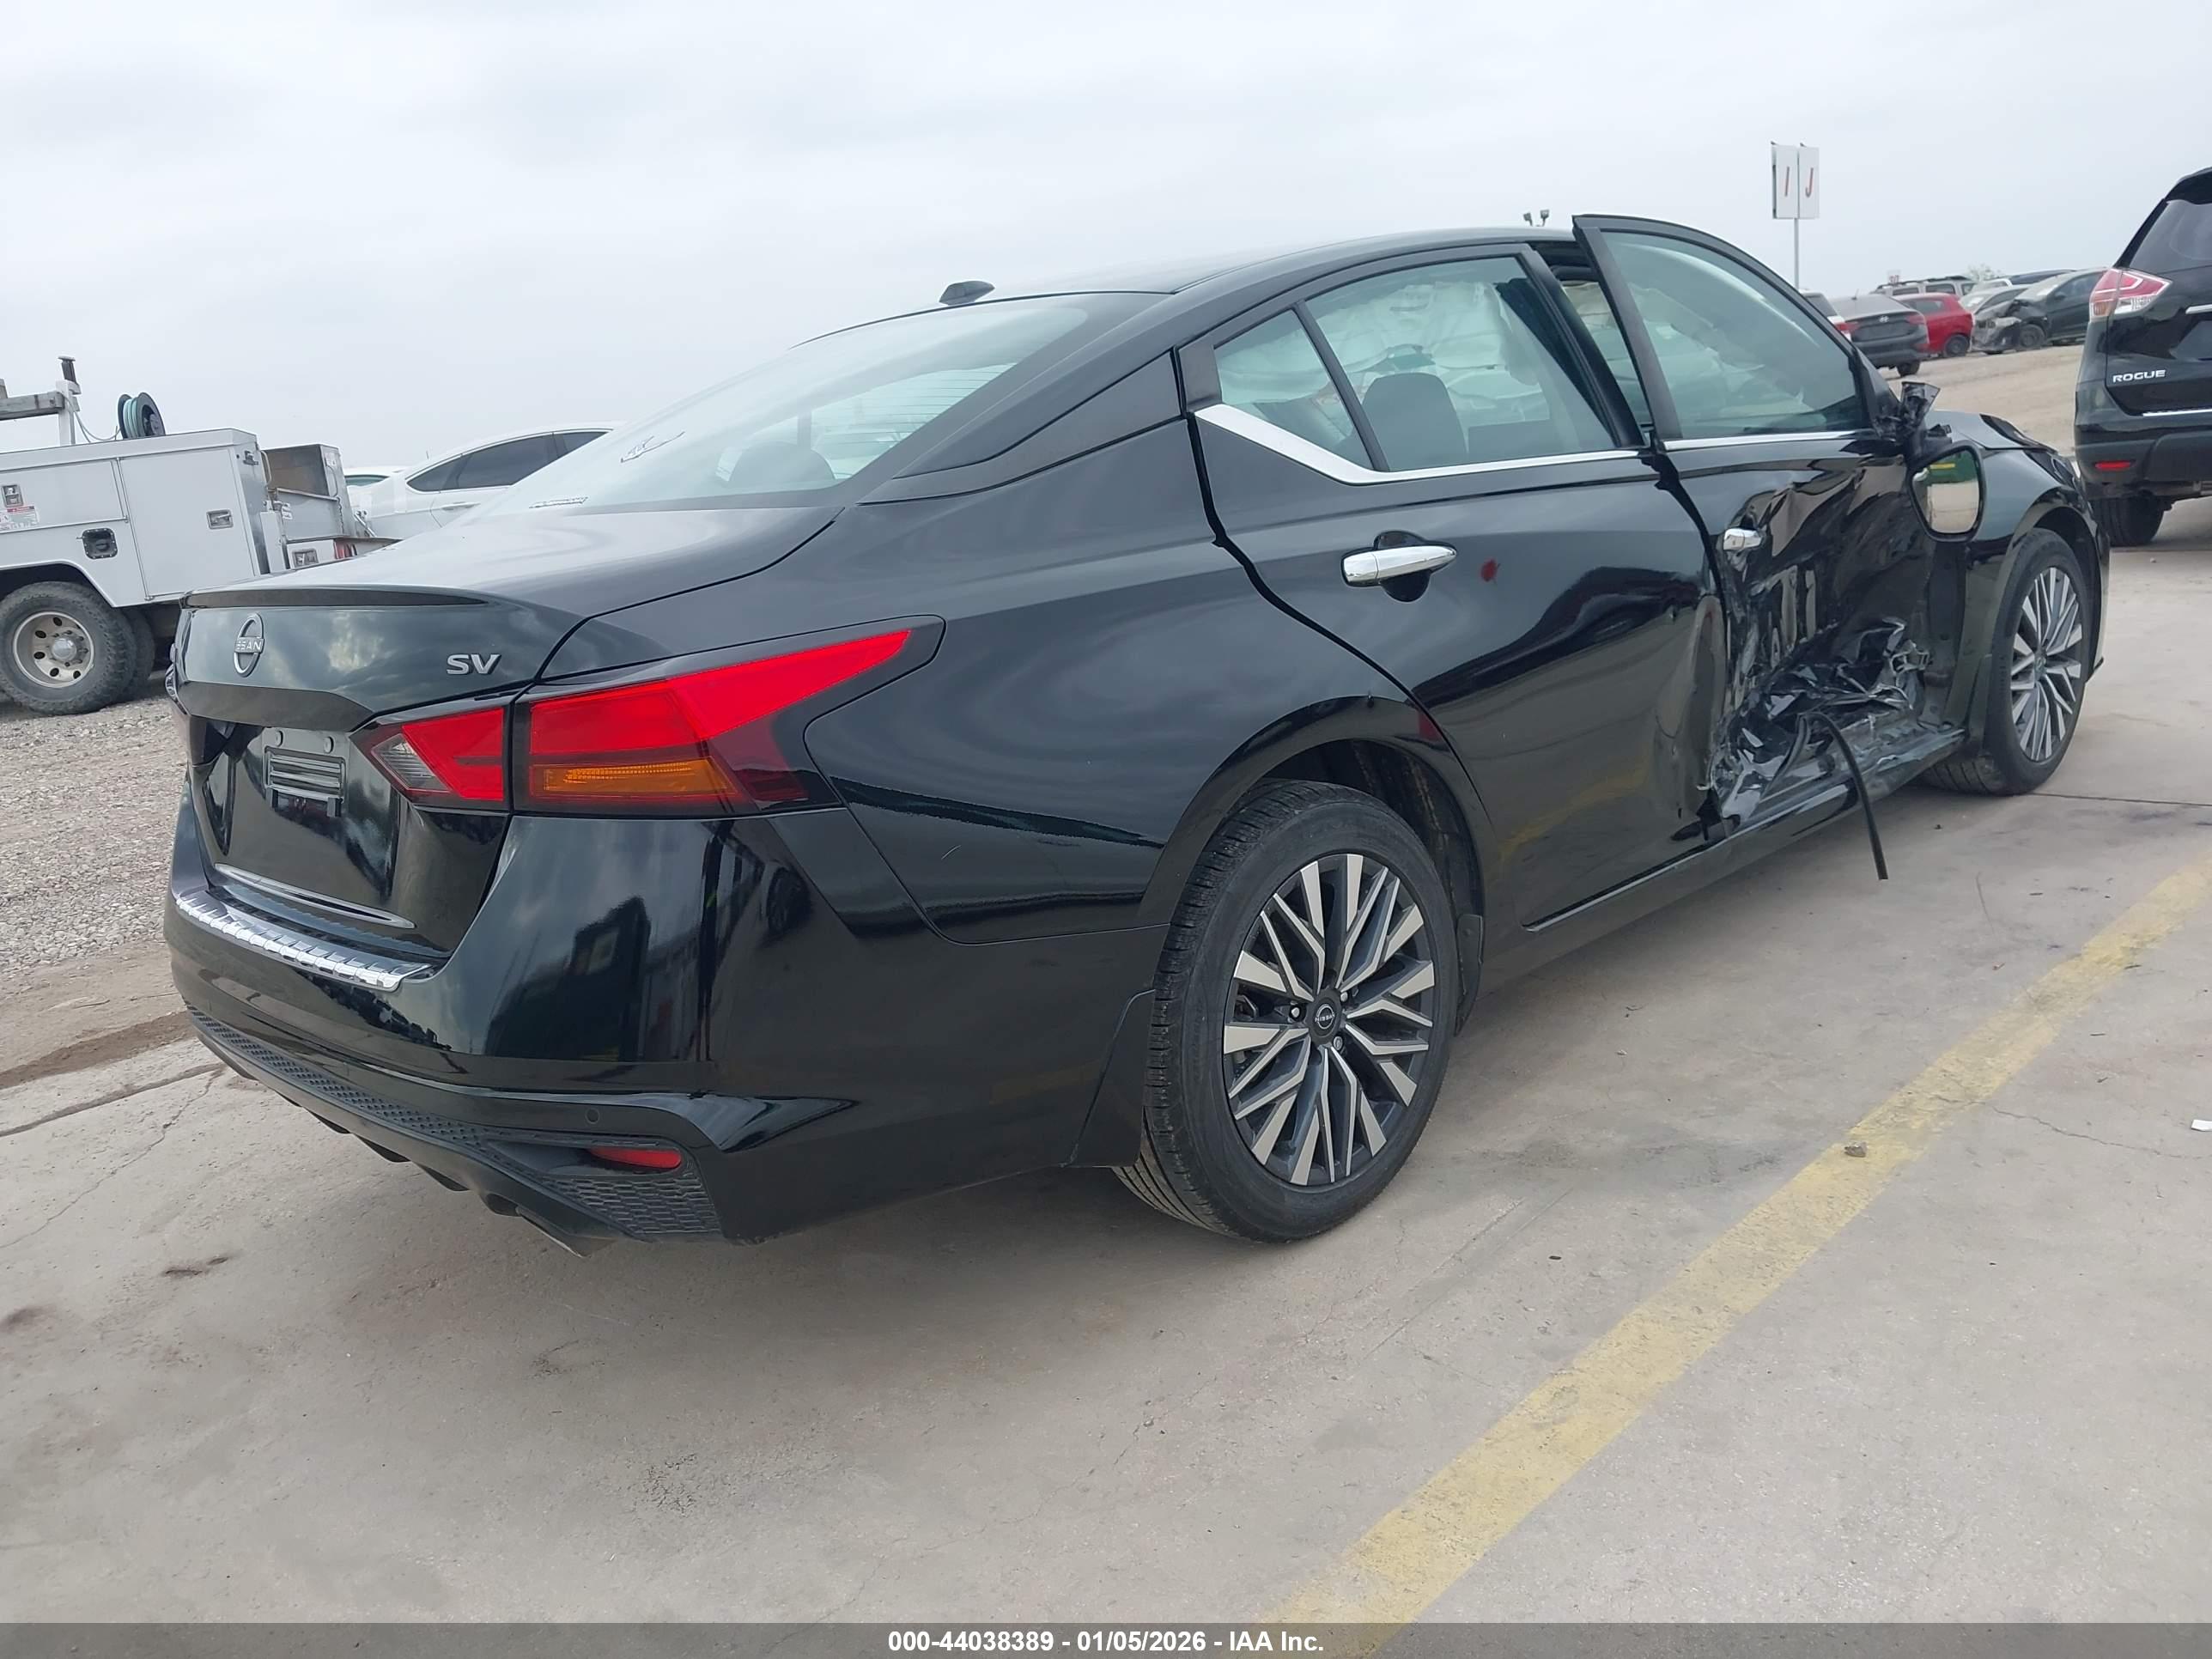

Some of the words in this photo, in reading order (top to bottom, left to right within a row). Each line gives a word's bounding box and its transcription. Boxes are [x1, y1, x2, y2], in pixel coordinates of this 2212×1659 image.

[1805, 167, 1814, 198] J
[2112, 369, 2166, 383] ROGUE
[235, 640, 263, 651] SSAN
[447, 654, 501, 675] SV
